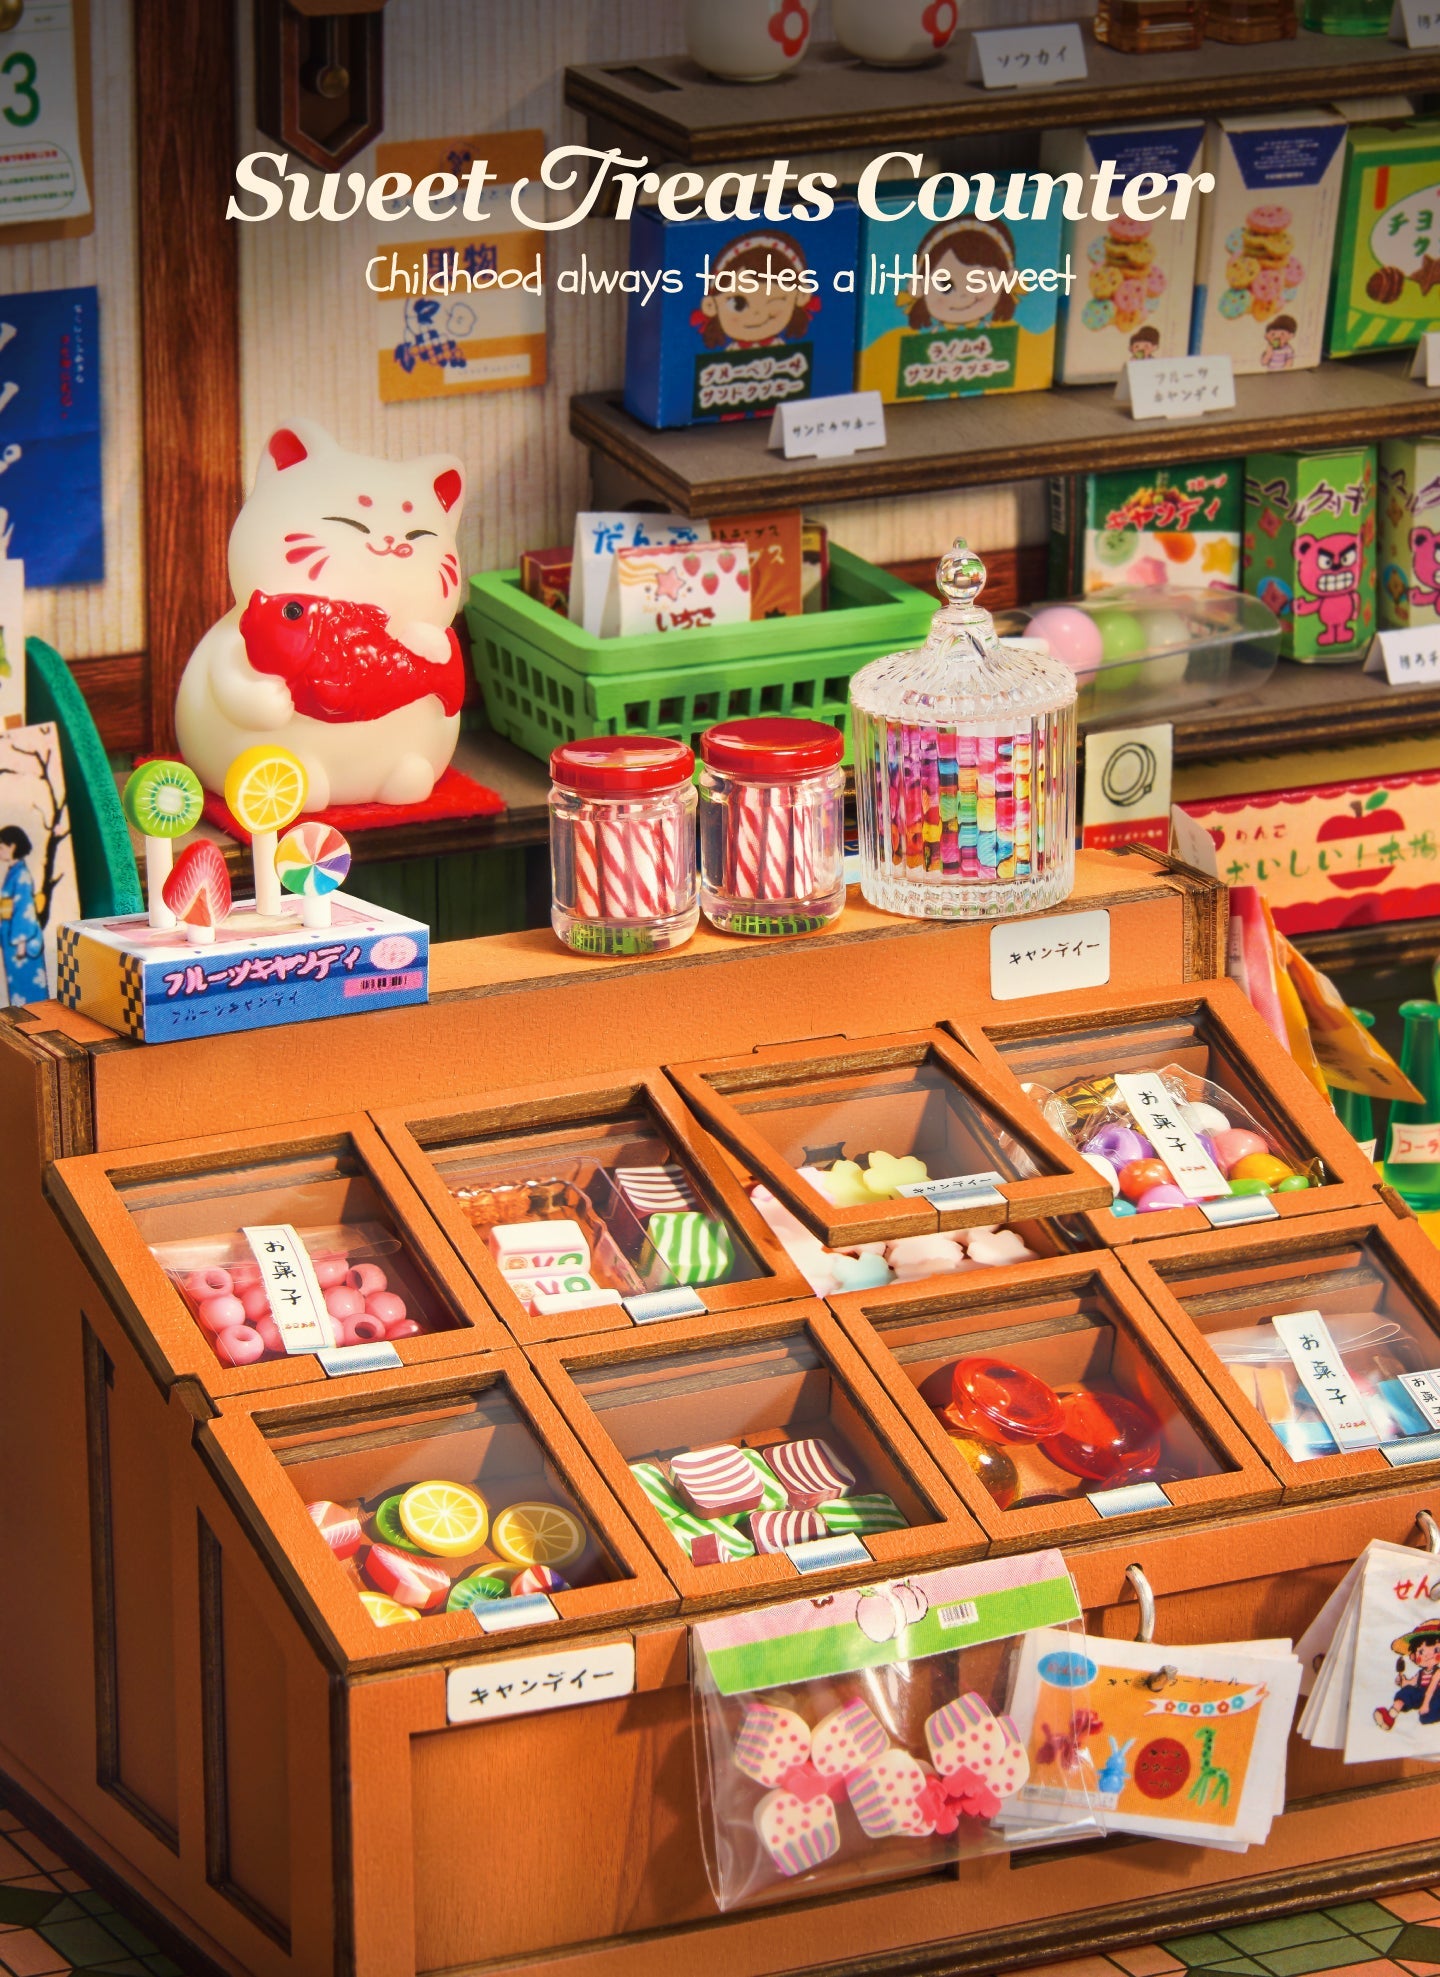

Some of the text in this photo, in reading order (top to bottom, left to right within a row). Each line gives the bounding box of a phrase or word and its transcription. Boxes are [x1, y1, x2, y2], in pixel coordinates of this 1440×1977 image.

[1138, 1090, 1188, 1153] お菓子
[263, 1240, 302, 1307] お菓子
[1299, 1333, 1347, 1405] お菓子
